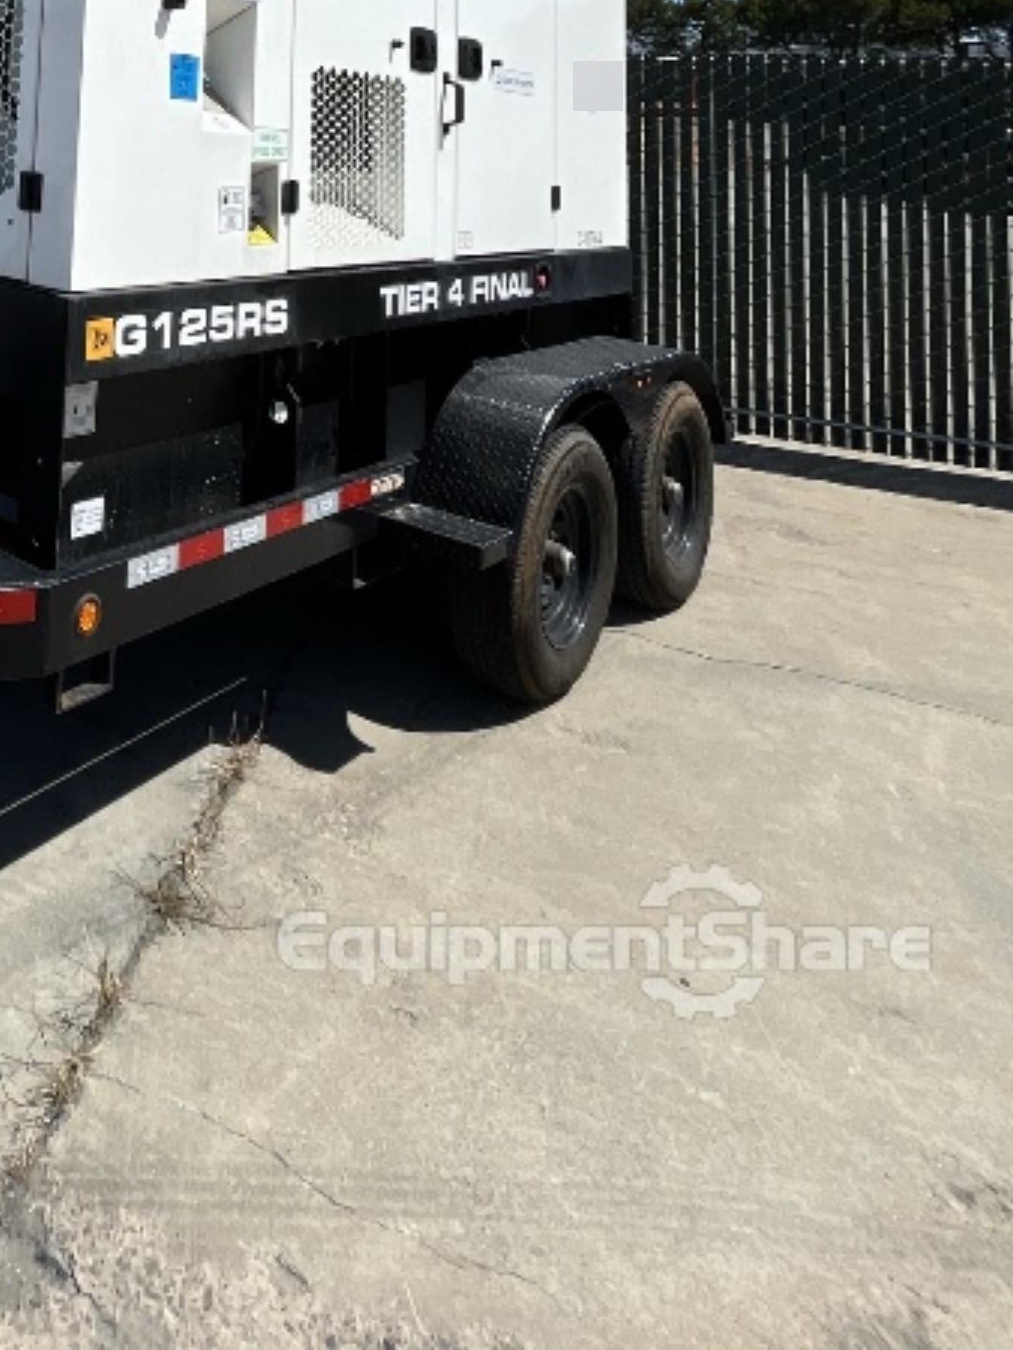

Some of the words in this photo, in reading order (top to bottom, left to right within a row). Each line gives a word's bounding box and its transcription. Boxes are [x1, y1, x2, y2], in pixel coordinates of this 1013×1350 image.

[379, 280, 439, 318] TIER
[448, 277, 465, 307] 4
[471, 271, 535, 305] FINAL
[114, 298, 289, 358] G125RS
